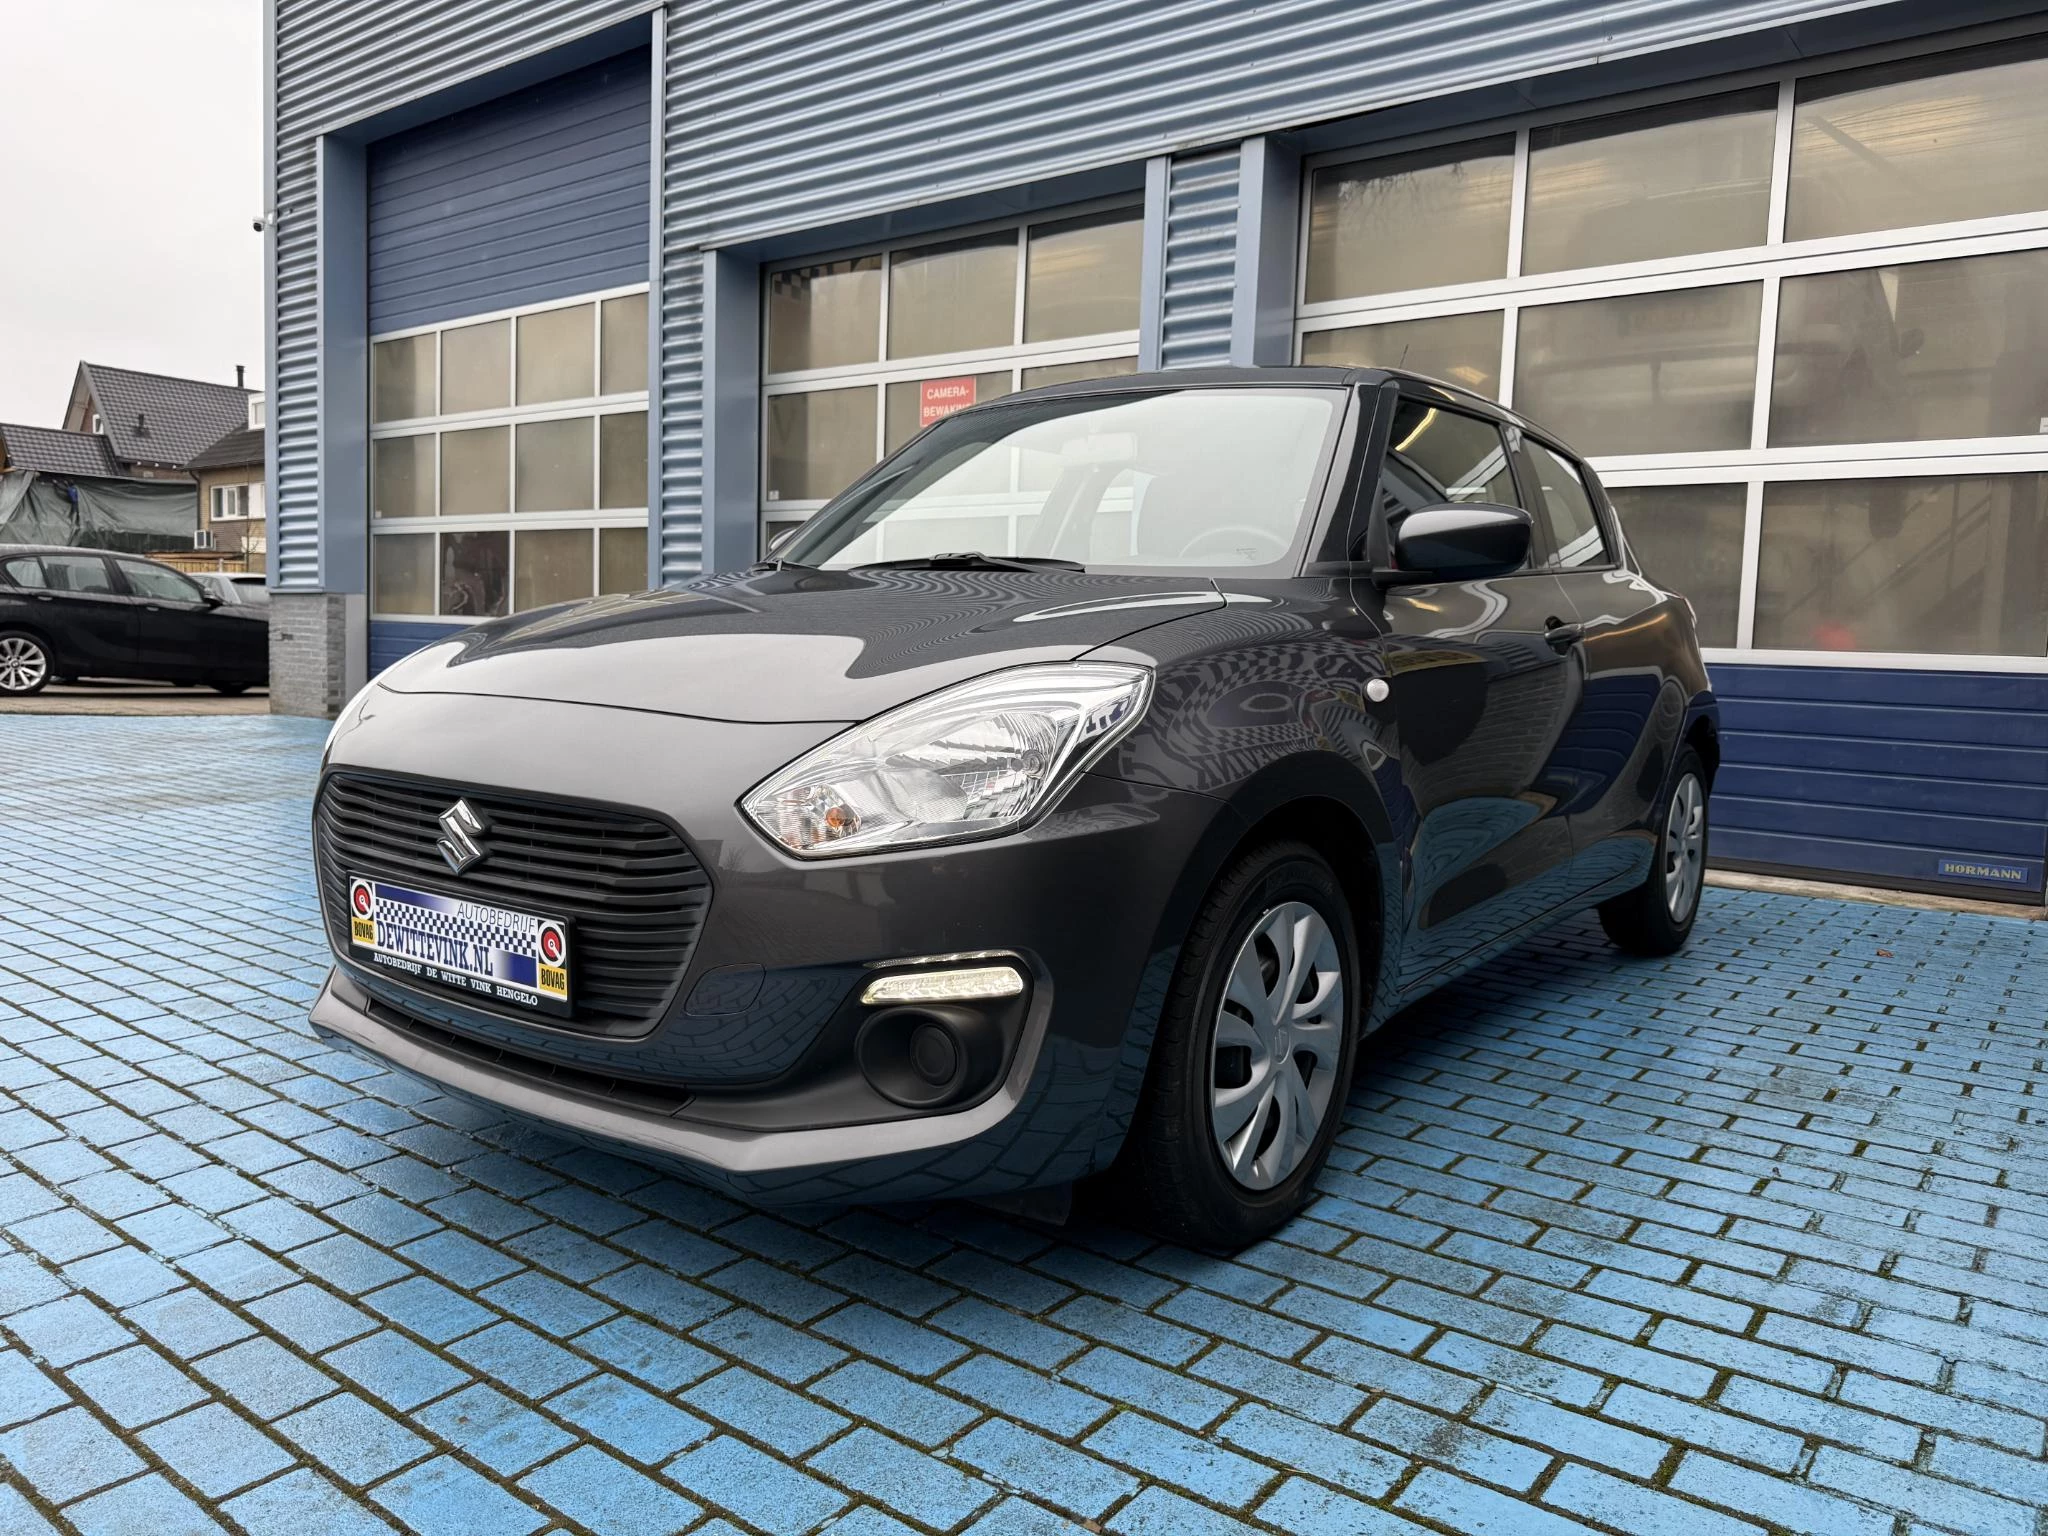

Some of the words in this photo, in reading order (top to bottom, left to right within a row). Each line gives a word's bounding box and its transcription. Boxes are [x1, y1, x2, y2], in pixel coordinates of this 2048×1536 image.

[927, 385, 970, 400] CAMERA-
[354, 920, 374, 940] BOVAG
[457, 902, 537, 934] AUTOBEDRIJF
[377, 920, 494, 977] DEWITTEVINK.NL
[374, 952, 422, 974] AUTOBEDRIJF
[426, 967, 438, 979] DE
[441, 971, 467, 987] WITTE
[470, 979, 492, 994] VINK
[496, 985, 539, 1006] HENGELO
[541, 968, 565, 991] BOVAG
